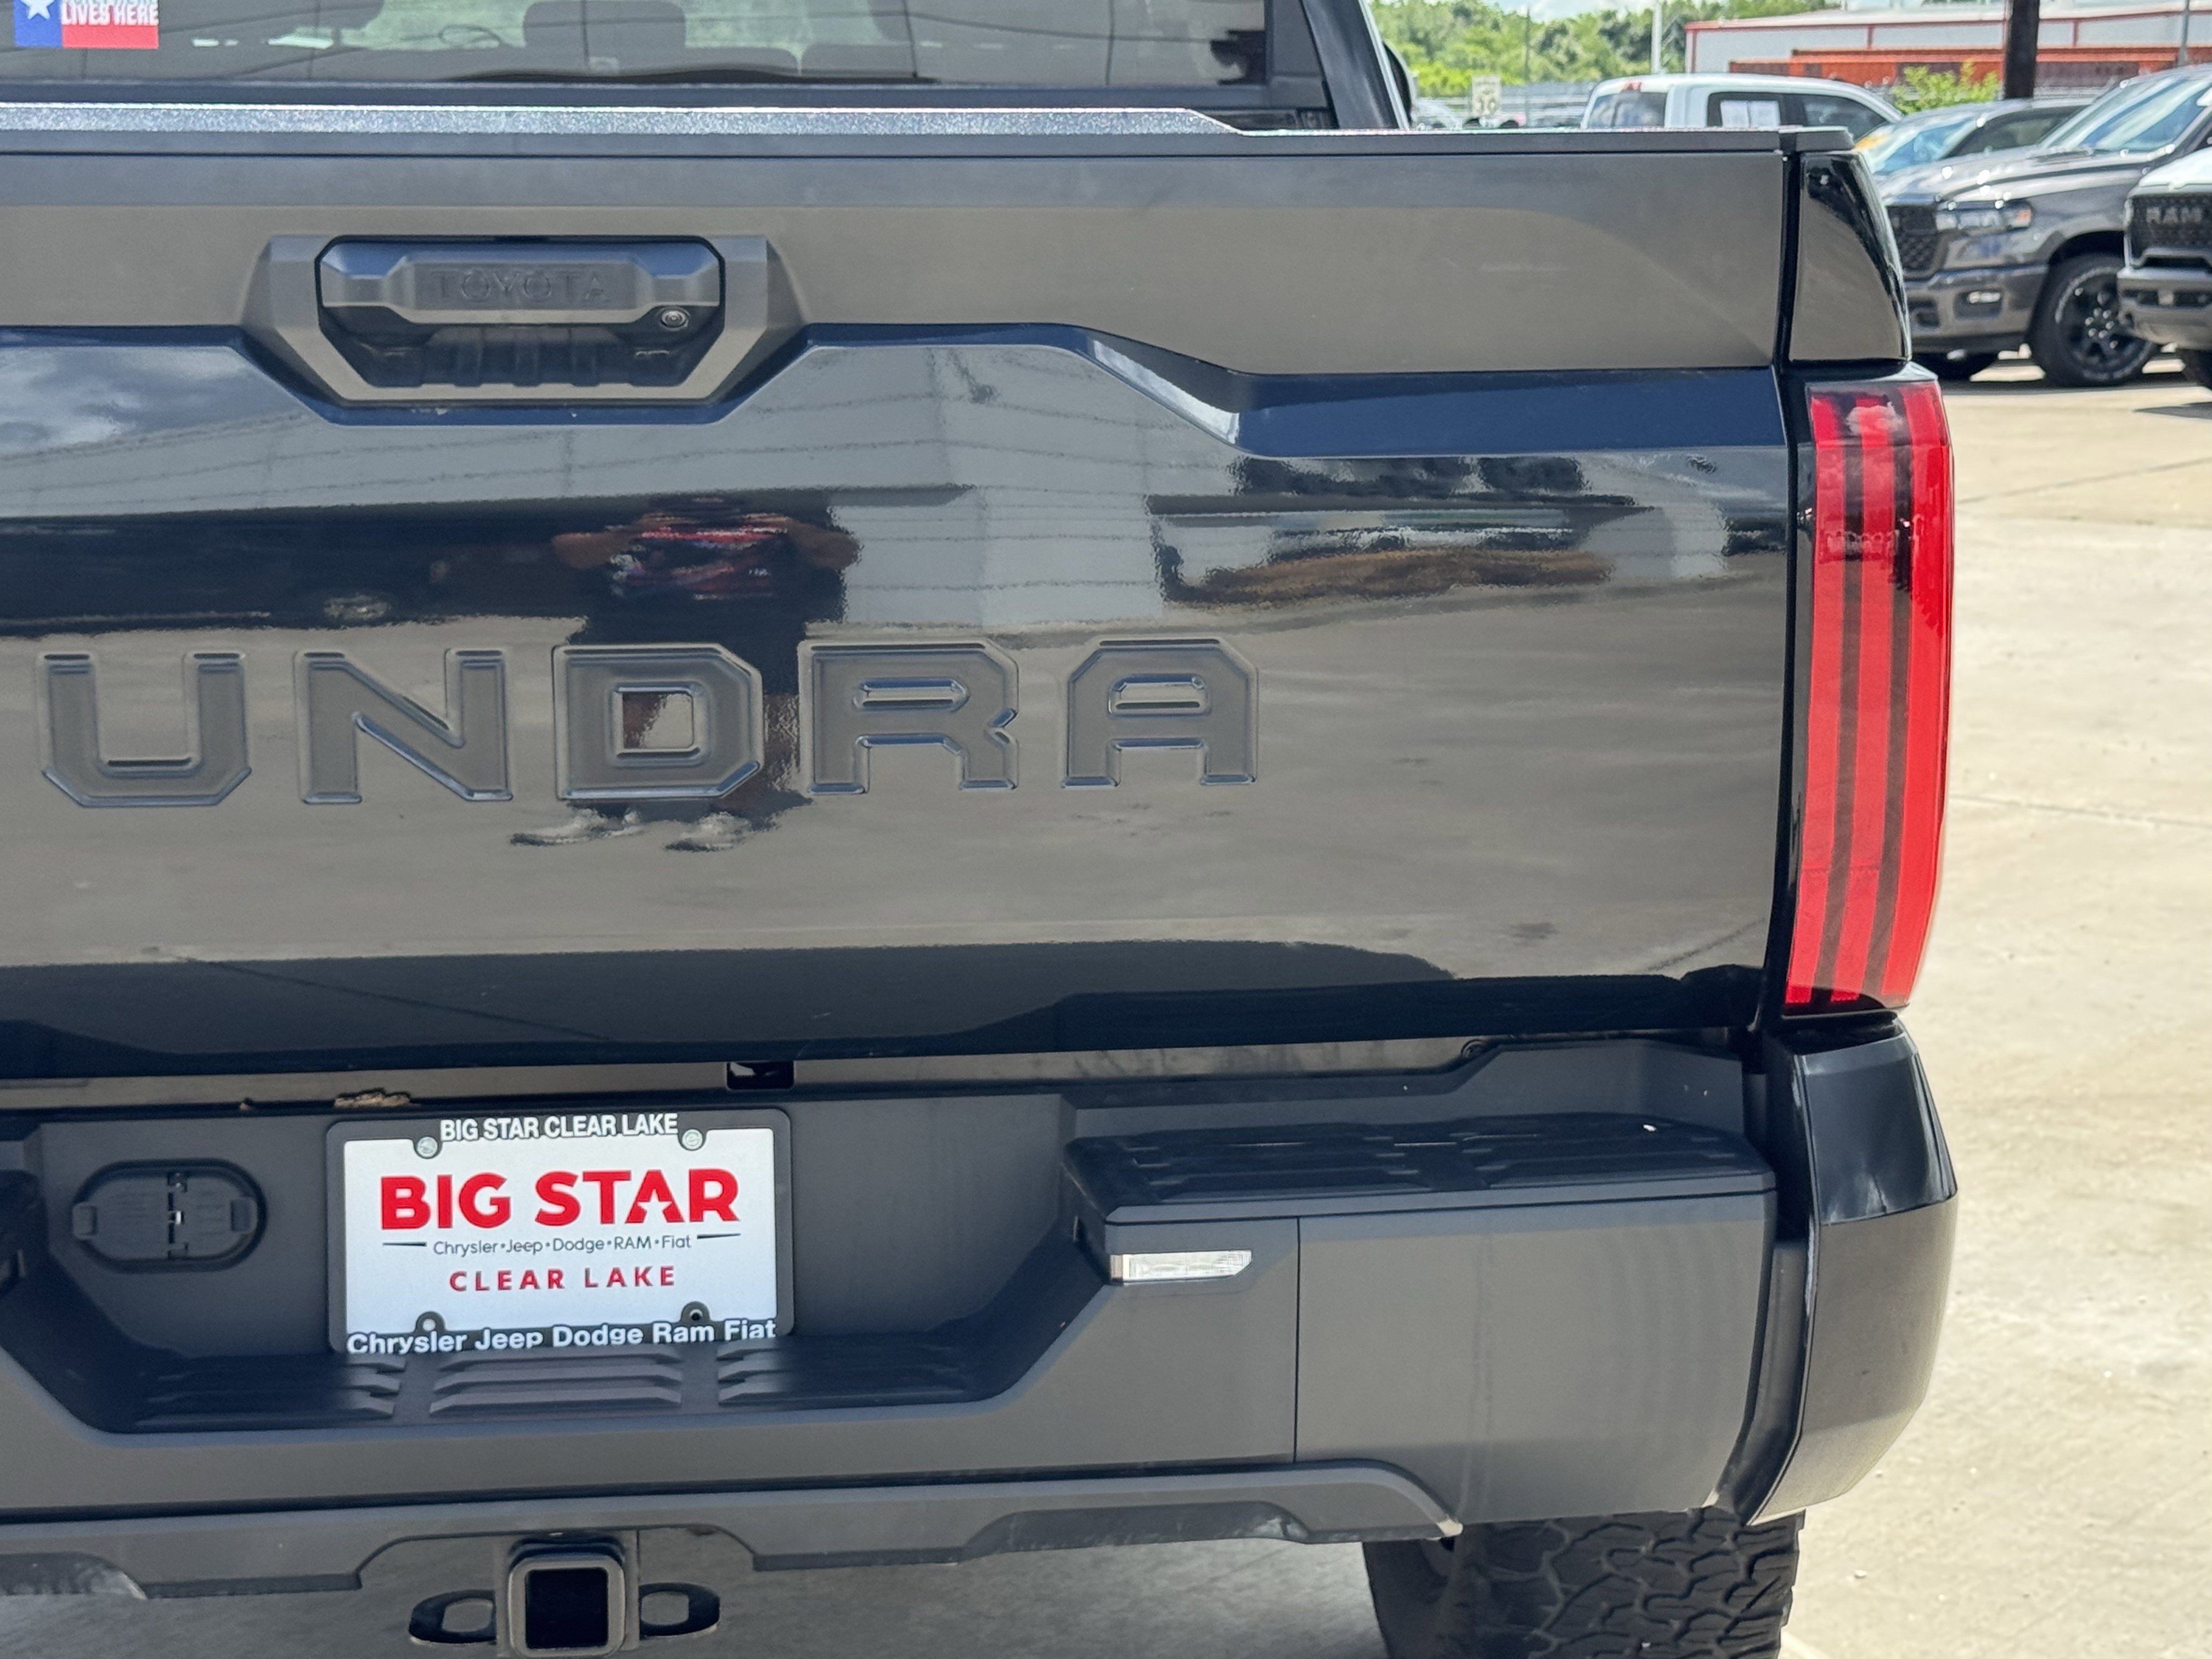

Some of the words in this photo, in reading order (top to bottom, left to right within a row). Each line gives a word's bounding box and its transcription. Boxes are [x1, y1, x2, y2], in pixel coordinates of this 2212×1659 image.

[61, 2, 110, 26] LIVES
[113, 3, 159, 26] HERE
[2146, 206, 2203, 224] RAM
[431, 268, 611, 302] TOYOTA
[441, 1119, 478, 1141] BIG
[483, 1117, 540, 1139] STAR
[545, 1115, 616, 1138] CLEAR
[622, 1113, 678, 1135] LAKE
[381, 1173, 511, 1230] BIG
[535, 1169, 740, 1227] STAR
[449, 1268, 565, 1292] CLEAR
[584, 1266, 675, 1288] LAKE
[347, 1330, 467, 1355] Chrysler
[475, 1328, 543, 1350] Jeep
[552, 1323, 644, 1347] Dodge
[653, 1323, 714, 1344] Ram
[724, 1319, 776, 1340] Fiat
